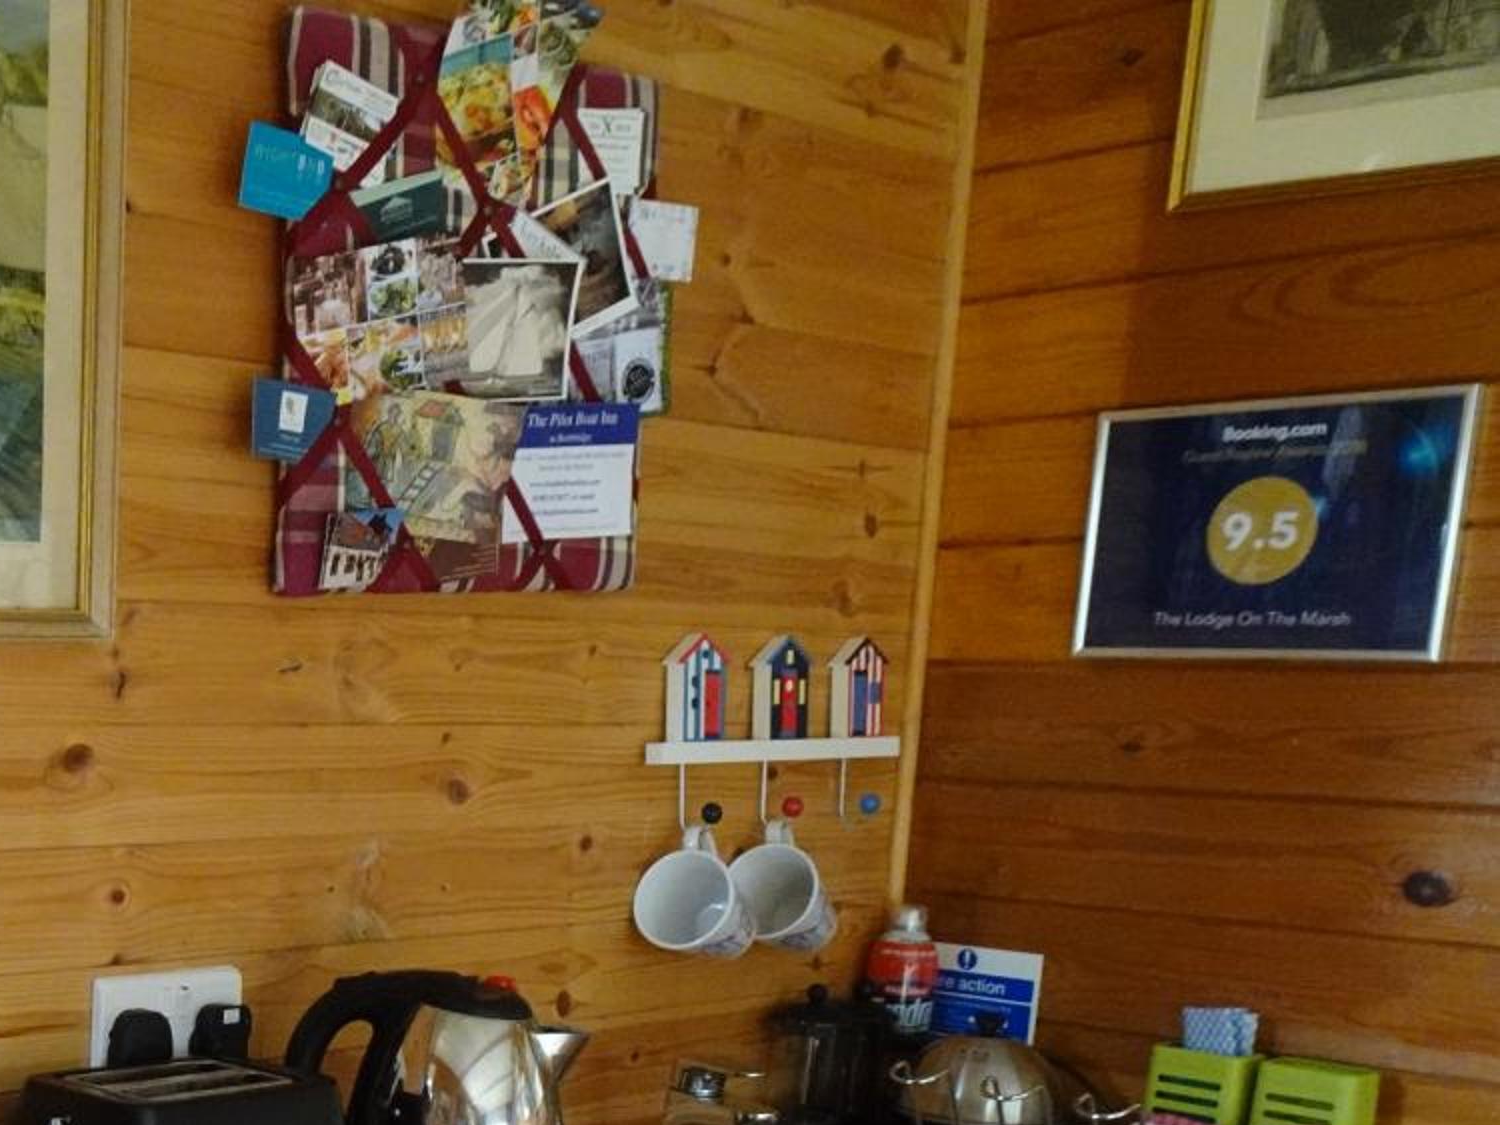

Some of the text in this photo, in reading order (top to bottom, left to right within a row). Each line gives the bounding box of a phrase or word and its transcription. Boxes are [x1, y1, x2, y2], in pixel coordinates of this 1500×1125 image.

[1222, 423, 1327, 442] Booking.com
[1224, 511, 1299, 551] 9.5
[1155, 609, 1350, 630] The Lodge On The Marsh
[958, 977, 1006, 996] action
